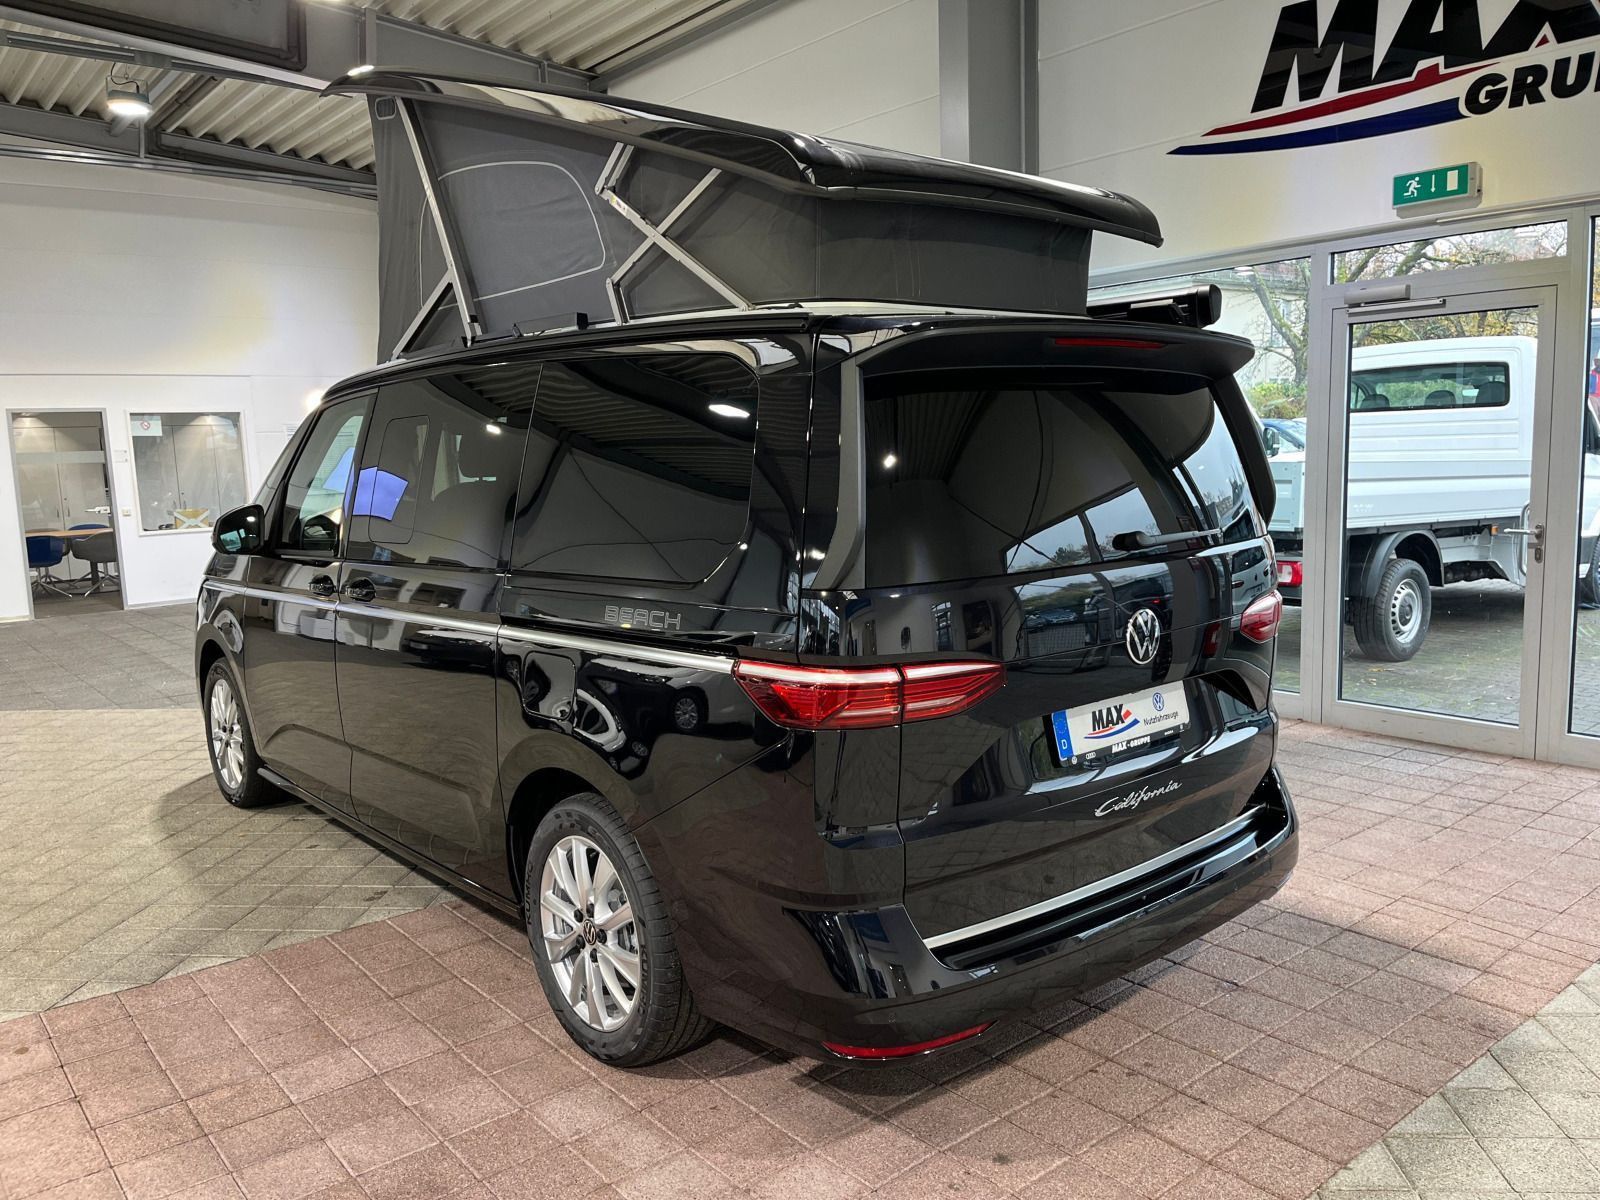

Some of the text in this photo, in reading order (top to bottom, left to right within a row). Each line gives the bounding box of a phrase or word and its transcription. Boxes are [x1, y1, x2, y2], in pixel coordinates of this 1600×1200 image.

[1464, 50, 1600, 115] GRU
[604, 605, 681, 630] BEACH
[1092, 704, 1125, 731] MAX
[1061, 739, 1067, 749] D
[1094, 780, 1182, 817] California
